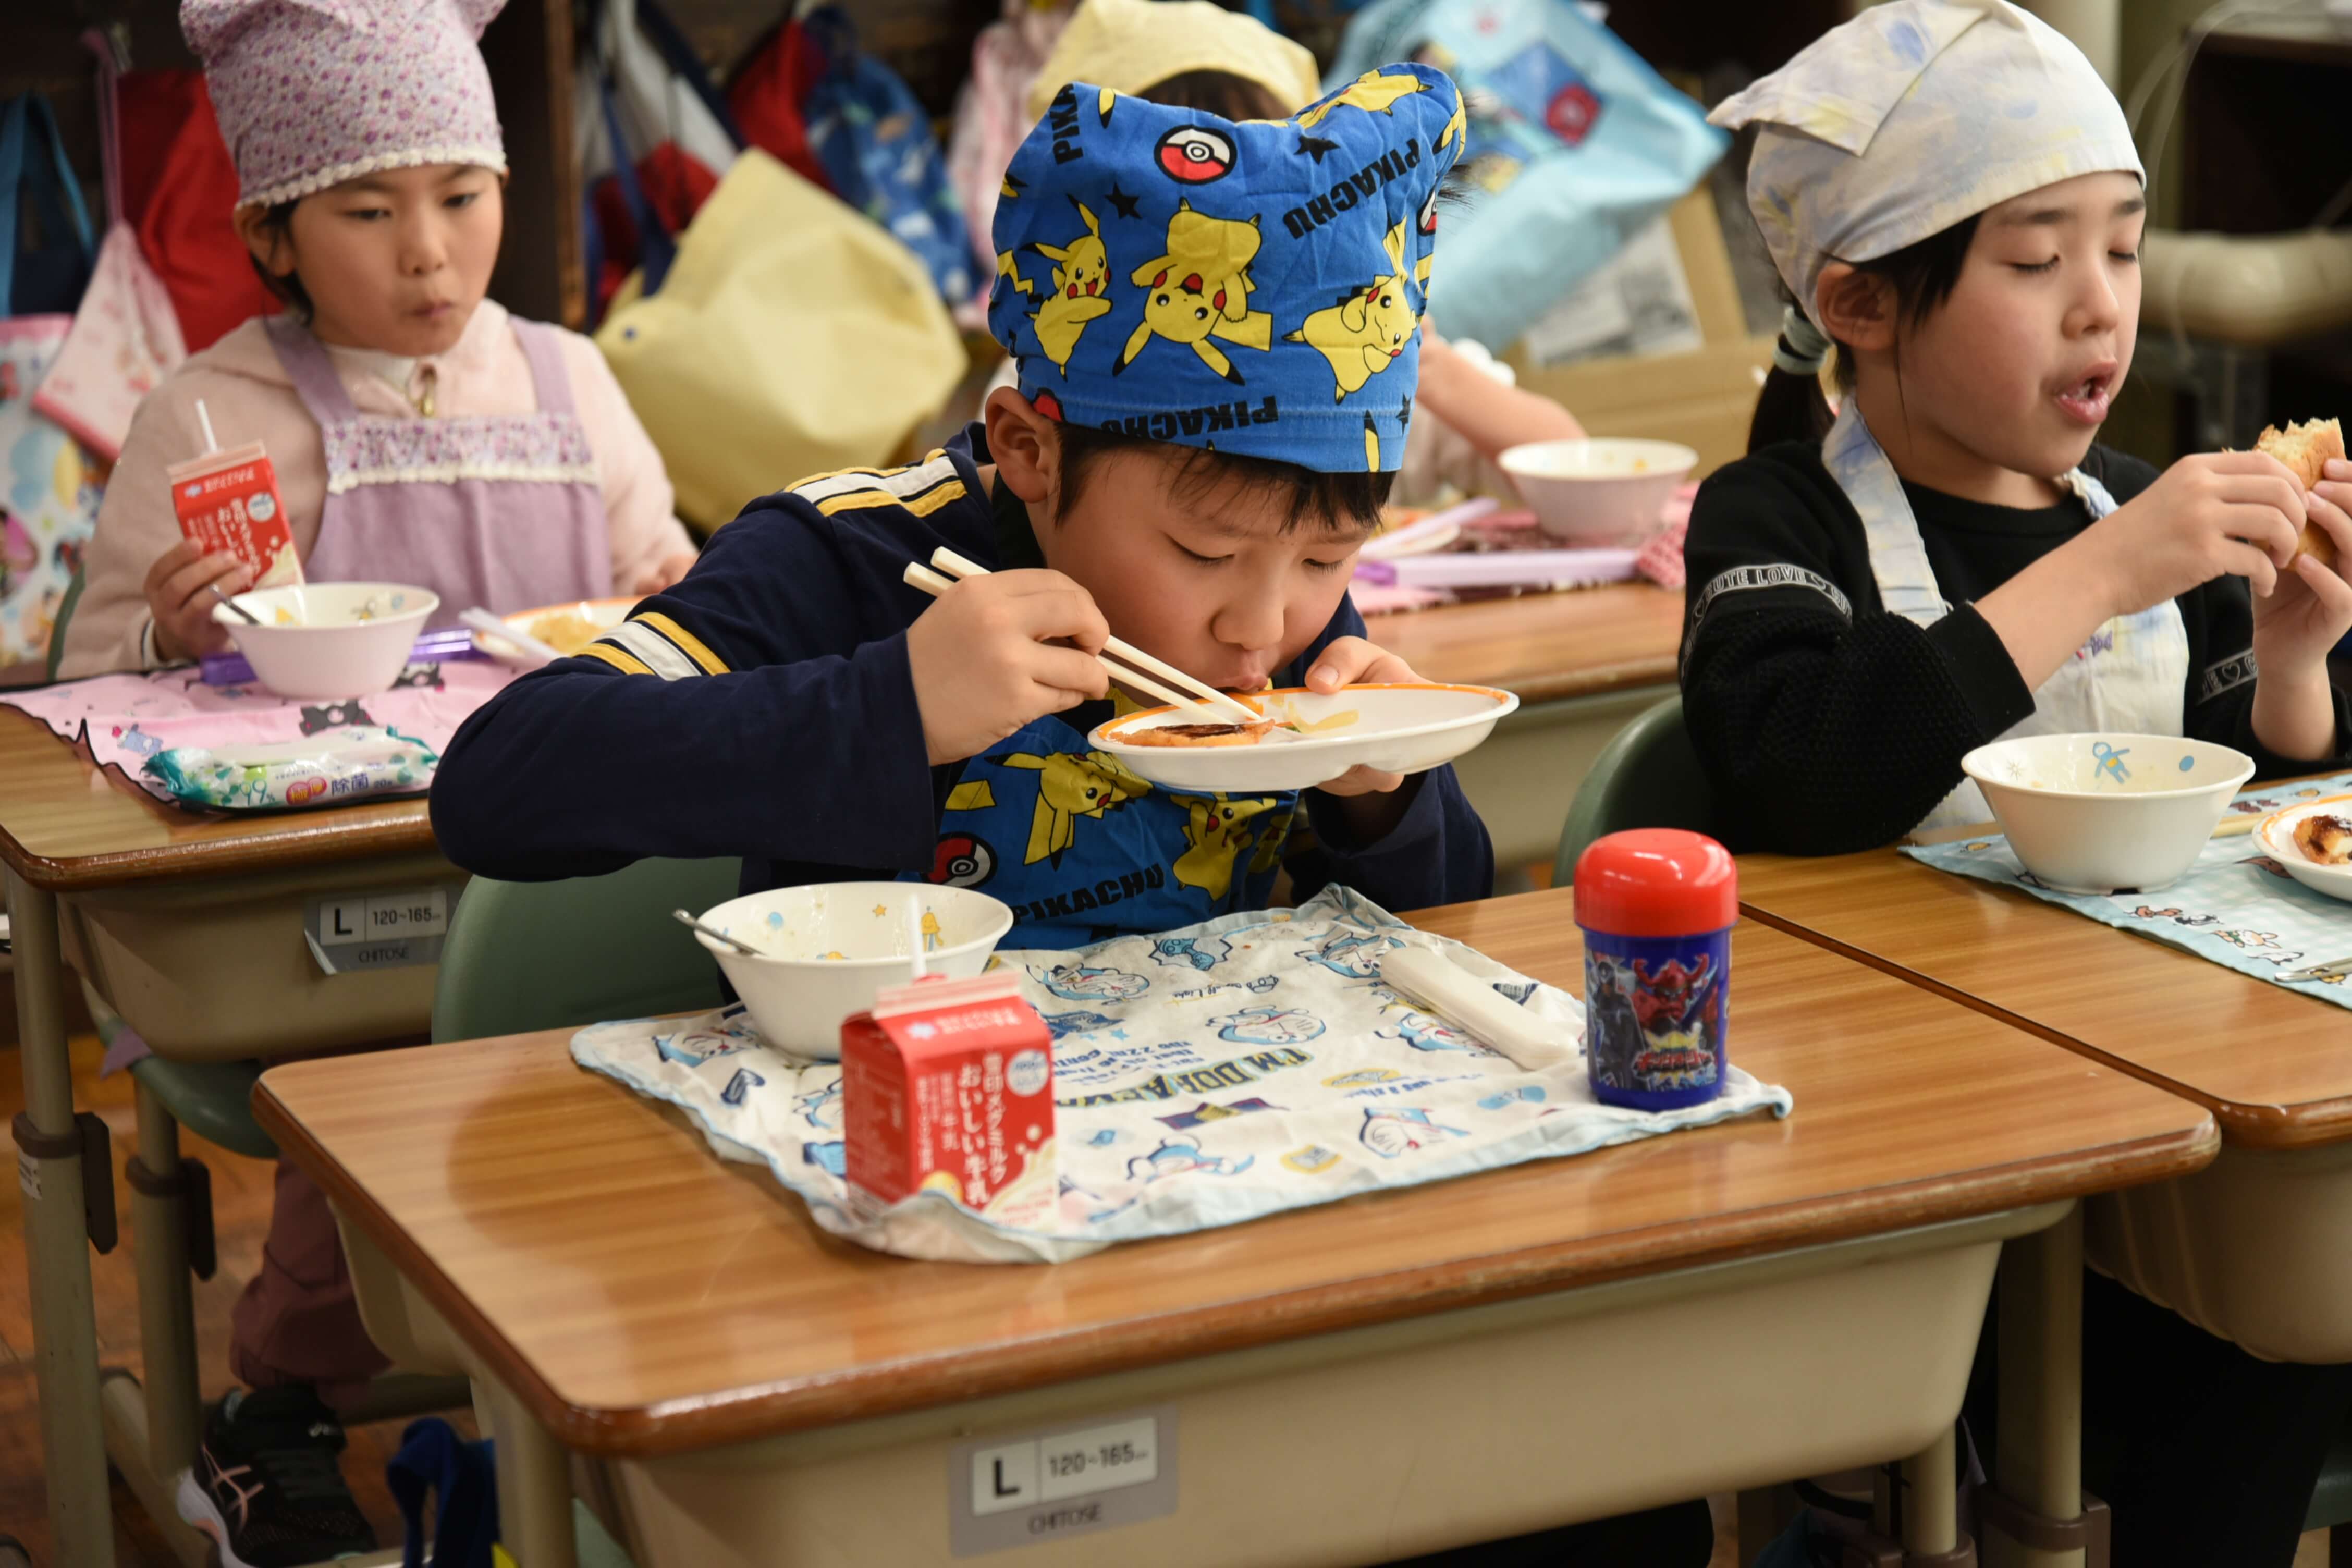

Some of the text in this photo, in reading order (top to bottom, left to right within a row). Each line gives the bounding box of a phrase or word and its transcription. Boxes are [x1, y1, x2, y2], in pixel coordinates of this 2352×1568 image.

[1282, 137, 1420, 239] PIKACHU
[1755, 566, 1807, 585] LOVE
[331, 774, 369, 796] 除菌
[1011, 863, 1165, 926] PIKACHU
[334, 908, 353, 936] L
[358, 946, 409, 963] CHITOSE
[959, 1064, 990, 1205] おいしい牛乳
[994, 1458, 1021, 1498] L
[1027, 1502, 1103, 1535] CHITOSE
